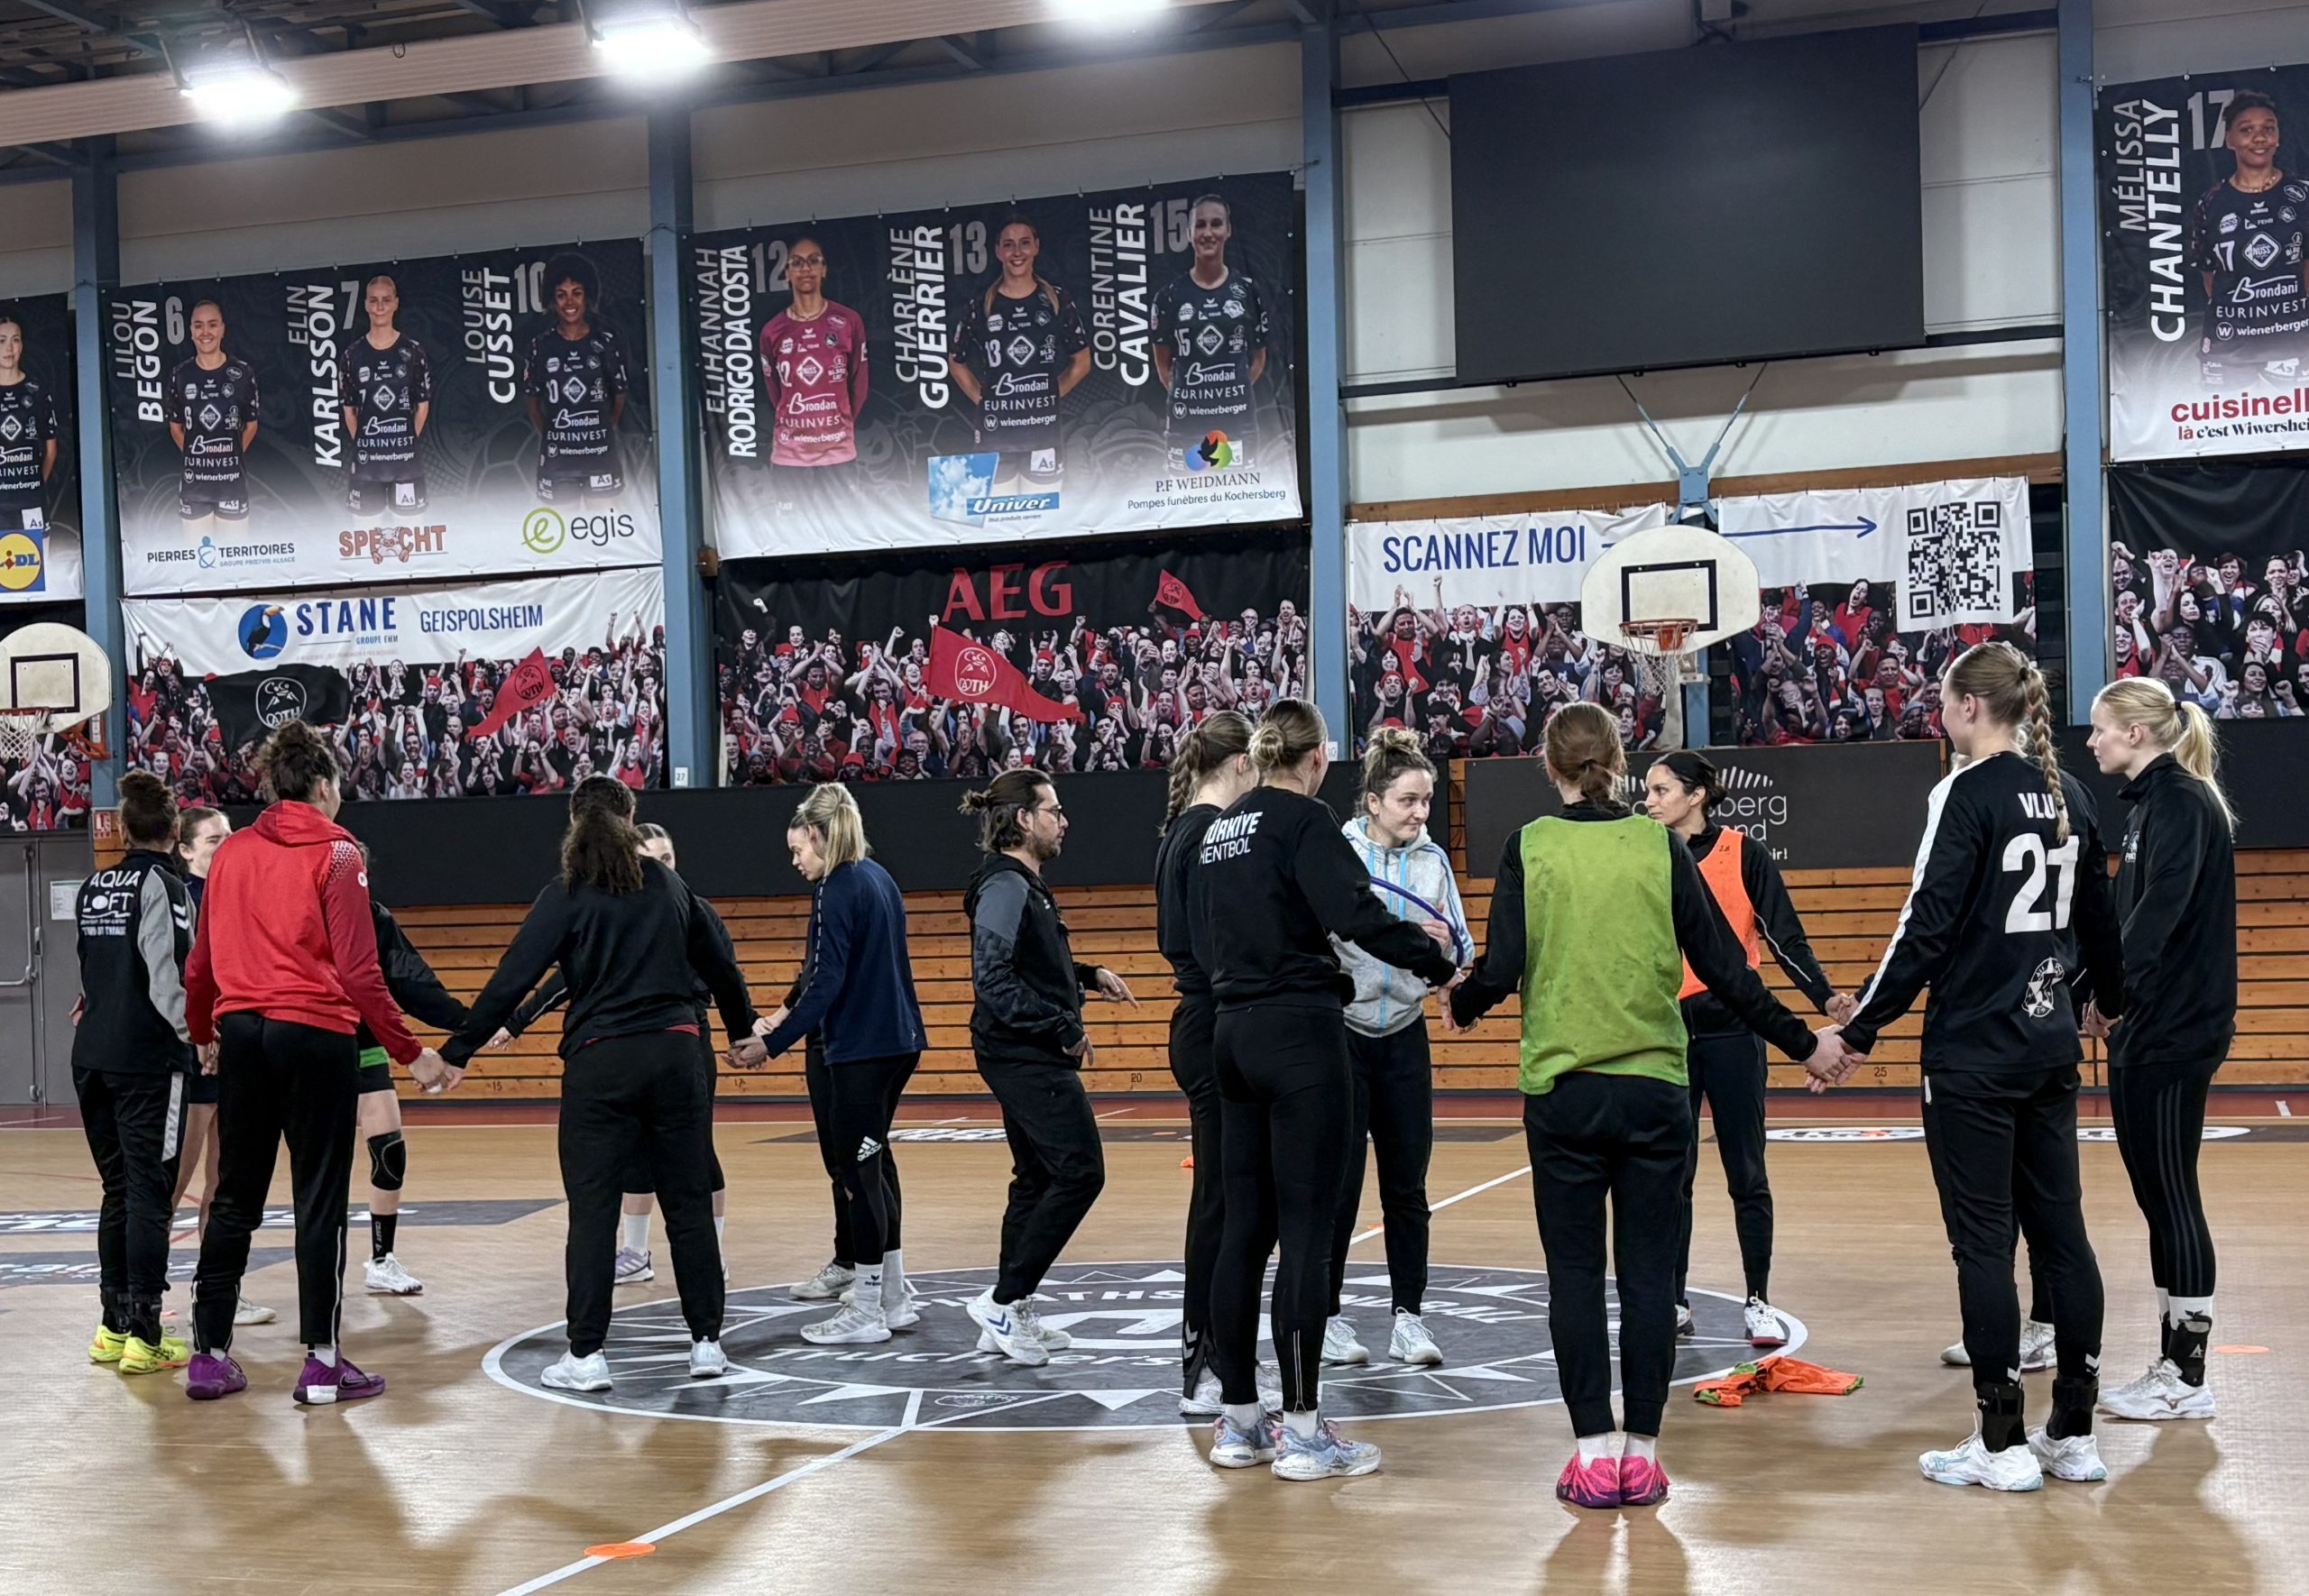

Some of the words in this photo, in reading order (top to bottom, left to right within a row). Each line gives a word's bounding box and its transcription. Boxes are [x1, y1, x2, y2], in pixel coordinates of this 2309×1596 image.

[2187, 89, 2234, 151] 17
[2112, 98, 2146, 232] MÉLISSA
[1150, 198, 1189, 254] 15
[2142, 98, 2185, 342] CHANTELLY
[752, 240, 789, 294] 12
[950, 221, 988, 275] 13
[2212, 240, 2235, 271] 17
[341, 280, 360, 330] 7
[721, 244, 751, 316] COSTA
[887, 227, 918, 383] CHARLÈNE
[1090, 207, 1117, 371] CORENTINE
[1116, 203, 1150, 387] CAVALIER
[165, 296, 185, 345] 6
[286, 285, 308, 345] ELIN
[462, 269, 486, 363] LOUISE
[695, 247, 725, 414] ELIHANNAH
[914, 225, 949, 409] GUERRIER
[2216, 298, 2308, 318] EURINVEST
[2237, 318, 2309, 336] wienerberger
[112, 302, 136, 379] LILOU
[483, 267, 516, 404] CUSSET
[132, 300, 164, 423] BEGON
[308, 285, 343, 468] KARLSSON
[725, 353, 757, 458] RODRIGO
[984, 395, 1057, 411] EURINVEST
[1173, 384, 1246, 399] EURINVEST
[1189, 403, 1247, 416] wienerberger
[547, 428, 607, 443] EURINVEST
[1000, 414, 1057, 427] wienerberger
[2178, 426, 2194, 440] là
[1039, 457, 1054, 470] As
[1176, 472, 1262, 491] WEIDMANN
[973, 497, 1051, 513] Univer
[1127, 499, 1165, 510] Pompes
[1167, 494, 1208, 506] funèbres
[1210, 492, 1222, 502] du
[1224, 490, 1286, 502] Kochersberg
[570, 508, 635, 546] egis
[1383, 529, 1520, 574] SCANNEZ
[1529, 524, 1586, 564] MOI
[147, 549, 196, 564] PIERRES
[218, 542, 295, 558] TERRITOIRES
[942, 560, 1073, 622] AEG
[296, 597, 397, 637] STANE
[419, 604, 543, 633] GEISPOLSHEIM
[2018, 793, 2069, 821] VLU
[90, 869, 142, 889] AQUA
[1771, 848, 1788, 860] ir!
[2001, 832, 2080, 934] 21
[1130, 1072, 1143, 1083] 20
[1873, 1067, 1888, 1078] 25
